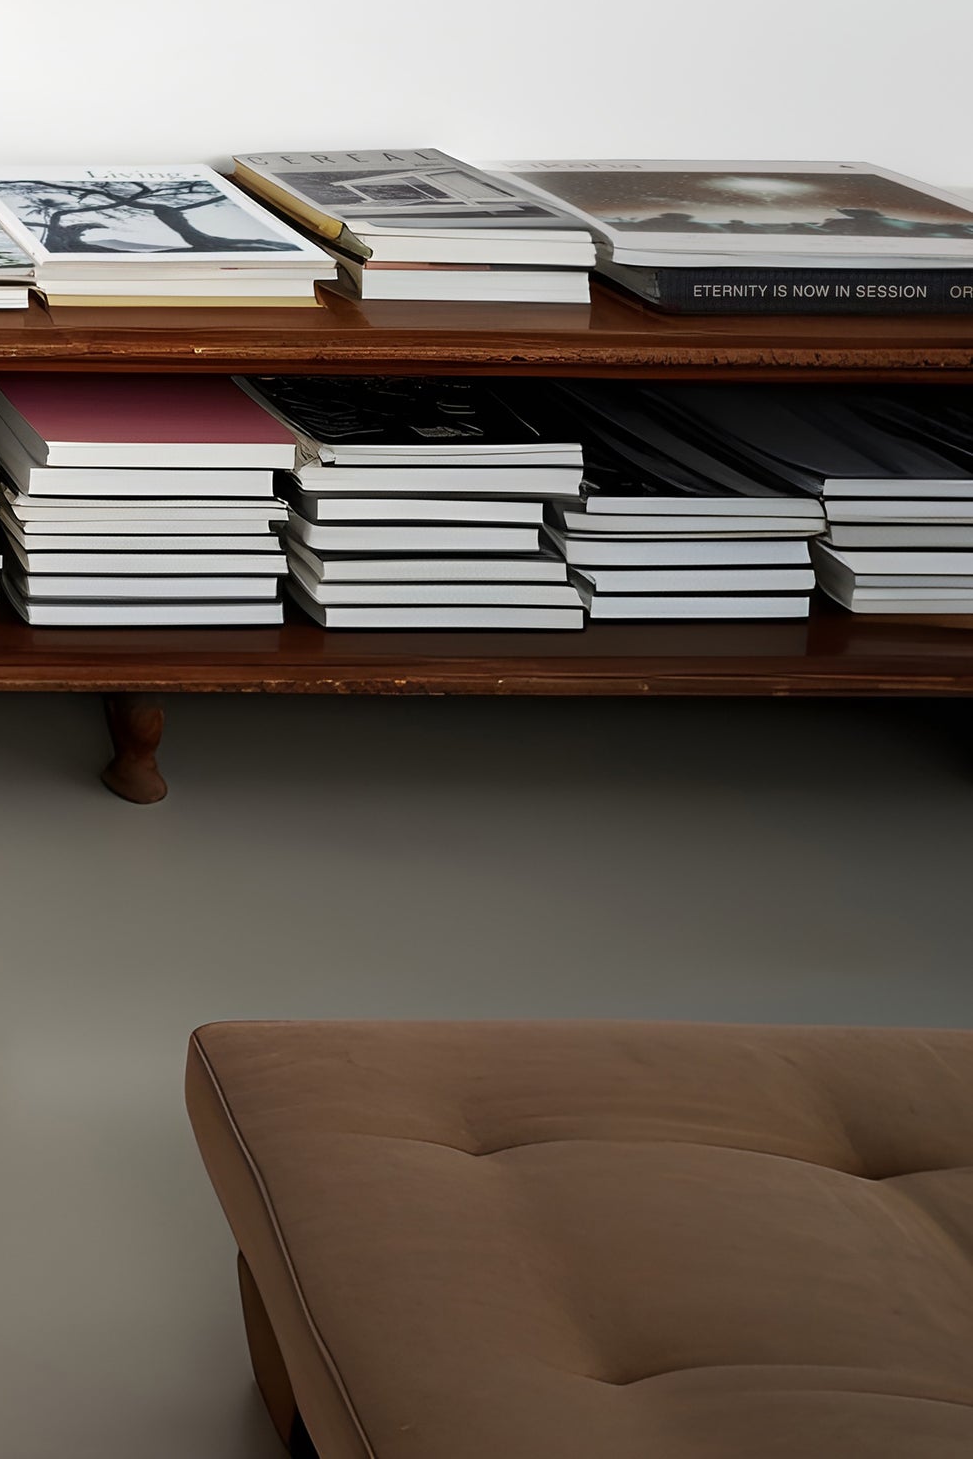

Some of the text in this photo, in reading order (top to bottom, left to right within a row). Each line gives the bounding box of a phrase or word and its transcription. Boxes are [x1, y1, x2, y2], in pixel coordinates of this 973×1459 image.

[246, 150, 440, 166] CEREAL
[693, 284, 927, 298] ETERNITY IS NOW IN SESSION
